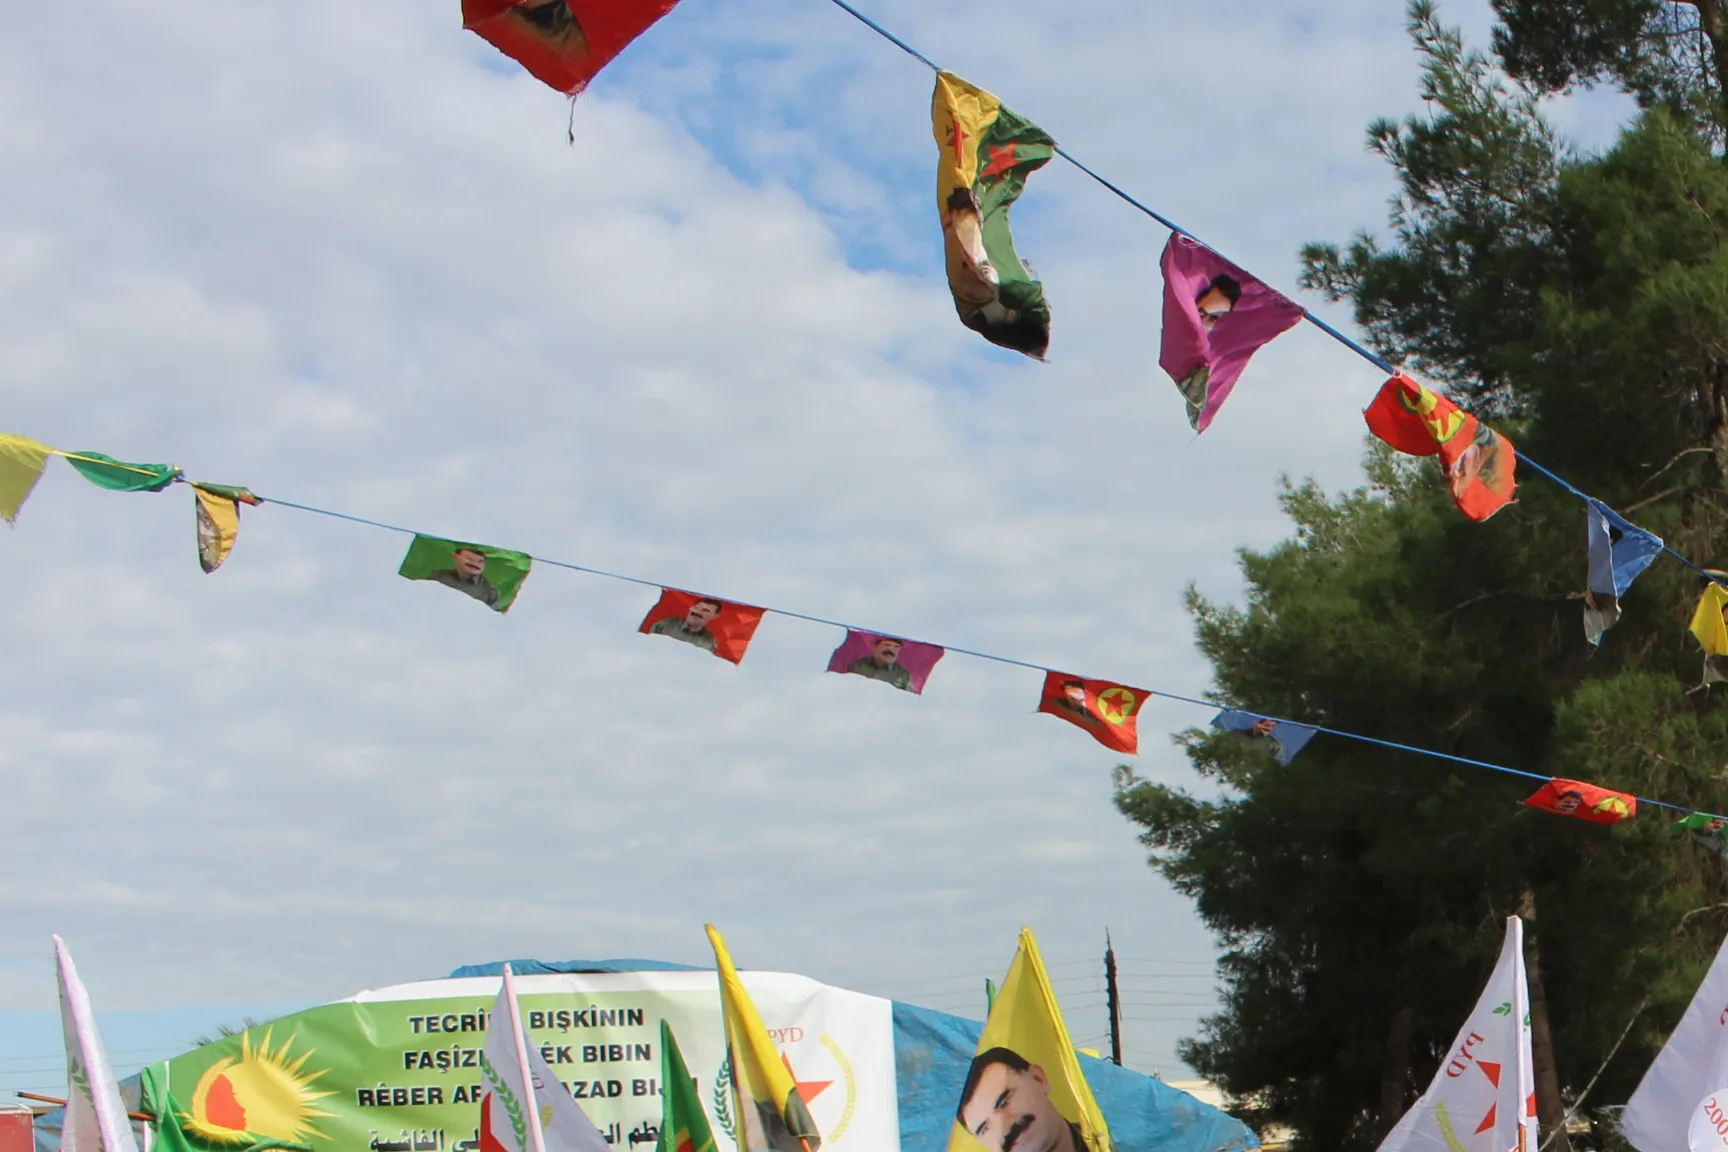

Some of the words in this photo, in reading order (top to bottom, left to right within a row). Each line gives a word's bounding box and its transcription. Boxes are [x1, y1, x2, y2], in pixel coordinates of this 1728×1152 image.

[409, 1007, 492, 1034] TECRÎ
[403, 1045, 484, 1073] FAŞÎZ
[583, 1044, 652, 1064] BIBIN
[357, 1083, 444, 1107] RÊBER
